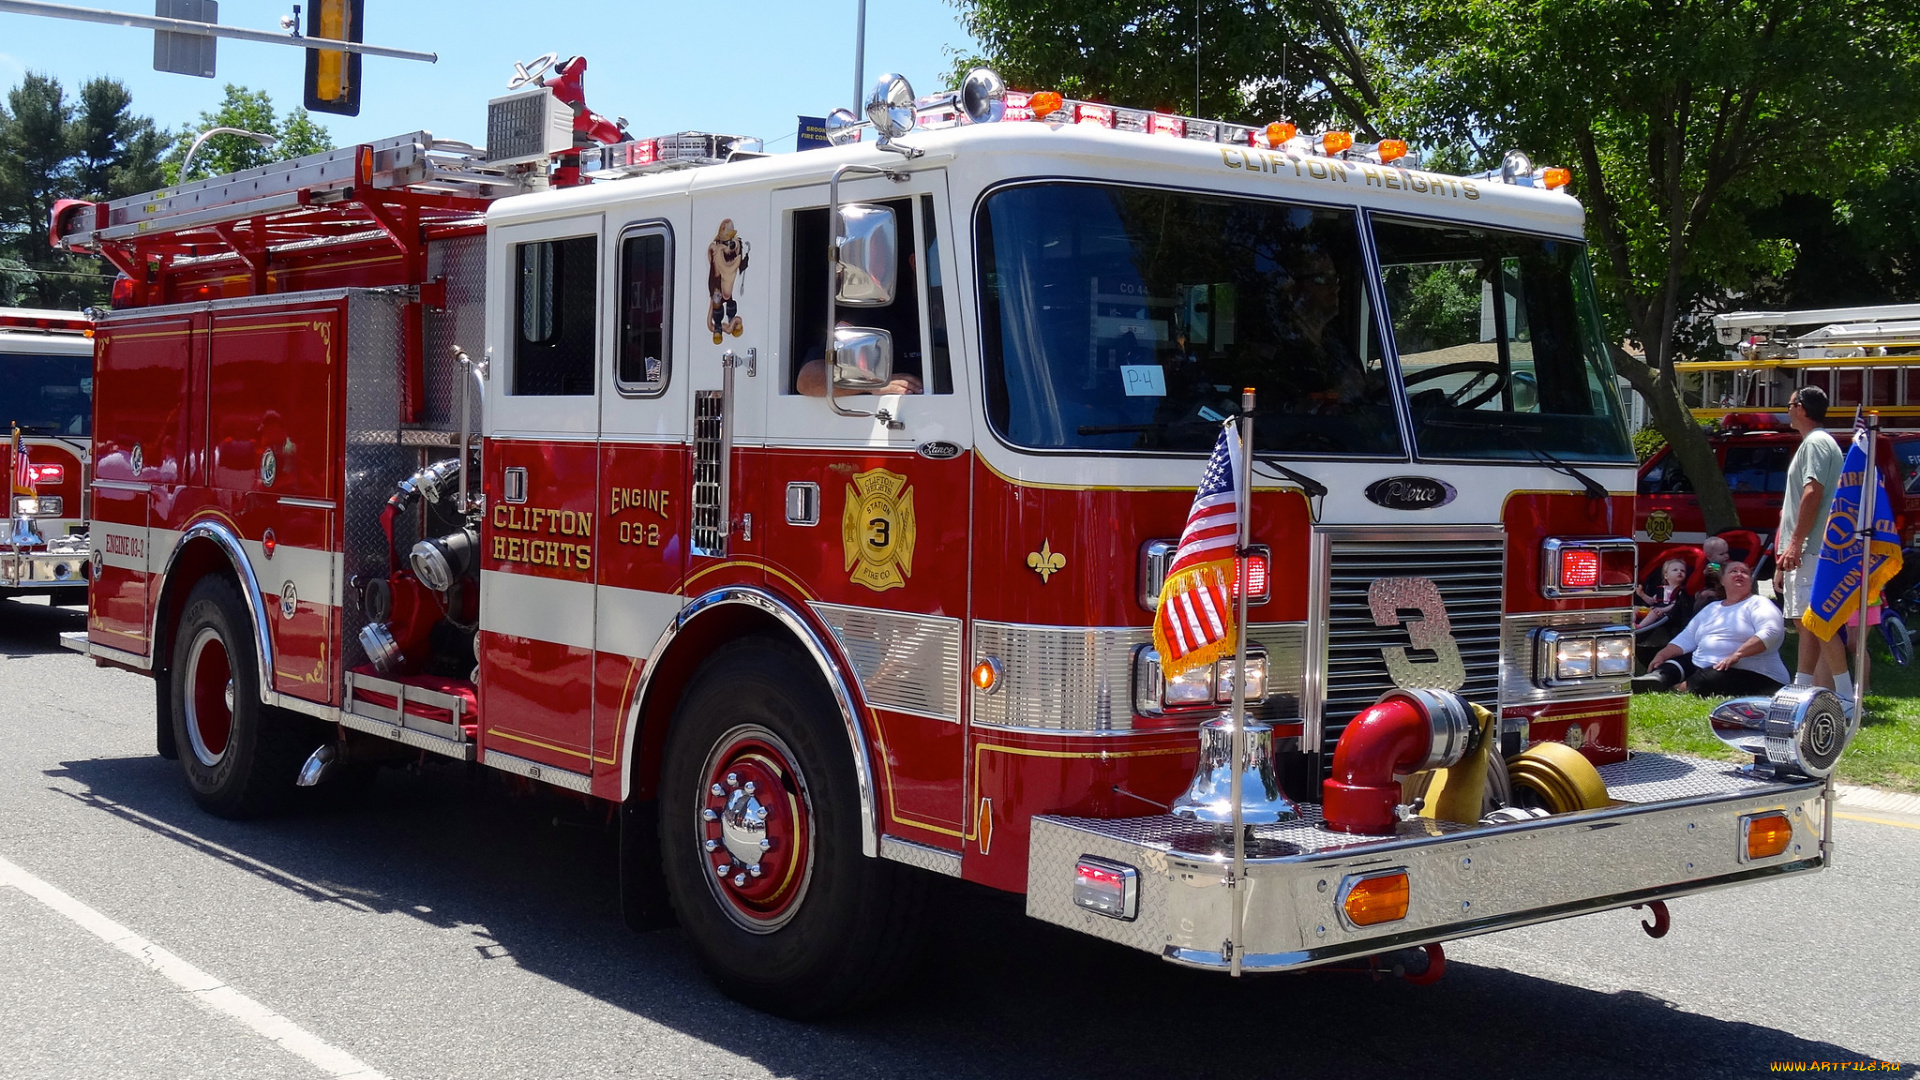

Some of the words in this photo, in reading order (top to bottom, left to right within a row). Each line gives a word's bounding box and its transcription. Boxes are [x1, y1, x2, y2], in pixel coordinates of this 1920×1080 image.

[1219, 147, 1348, 183] CLIFTON
[1361, 166, 1480, 201] HEIGHTS
[924, 442, 955, 456] Lance
[865, 476, 895, 489] CLIFTON
[865, 484, 893, 496] HEIGHTS
[1384, 481, 1437, 504] Pierce
[611, 486, 670, 519] ENGINE
[866, 501, 892, 516] STATION
[492, 505, 593, 538] CLIFTON
[869, 518, 890, 548] 3
[1654, 521, 1666, 532] 20
[106, 533, 130, 556] ENGINE
[492, 536, 592, 570] HEIGHTS
[863, 567, 879, 580] FIRE
[880, 569, 891, 580] CO
[1821, 567, 1862, 613] CLIFTON
[1368, 577, 1467, 692] 3
